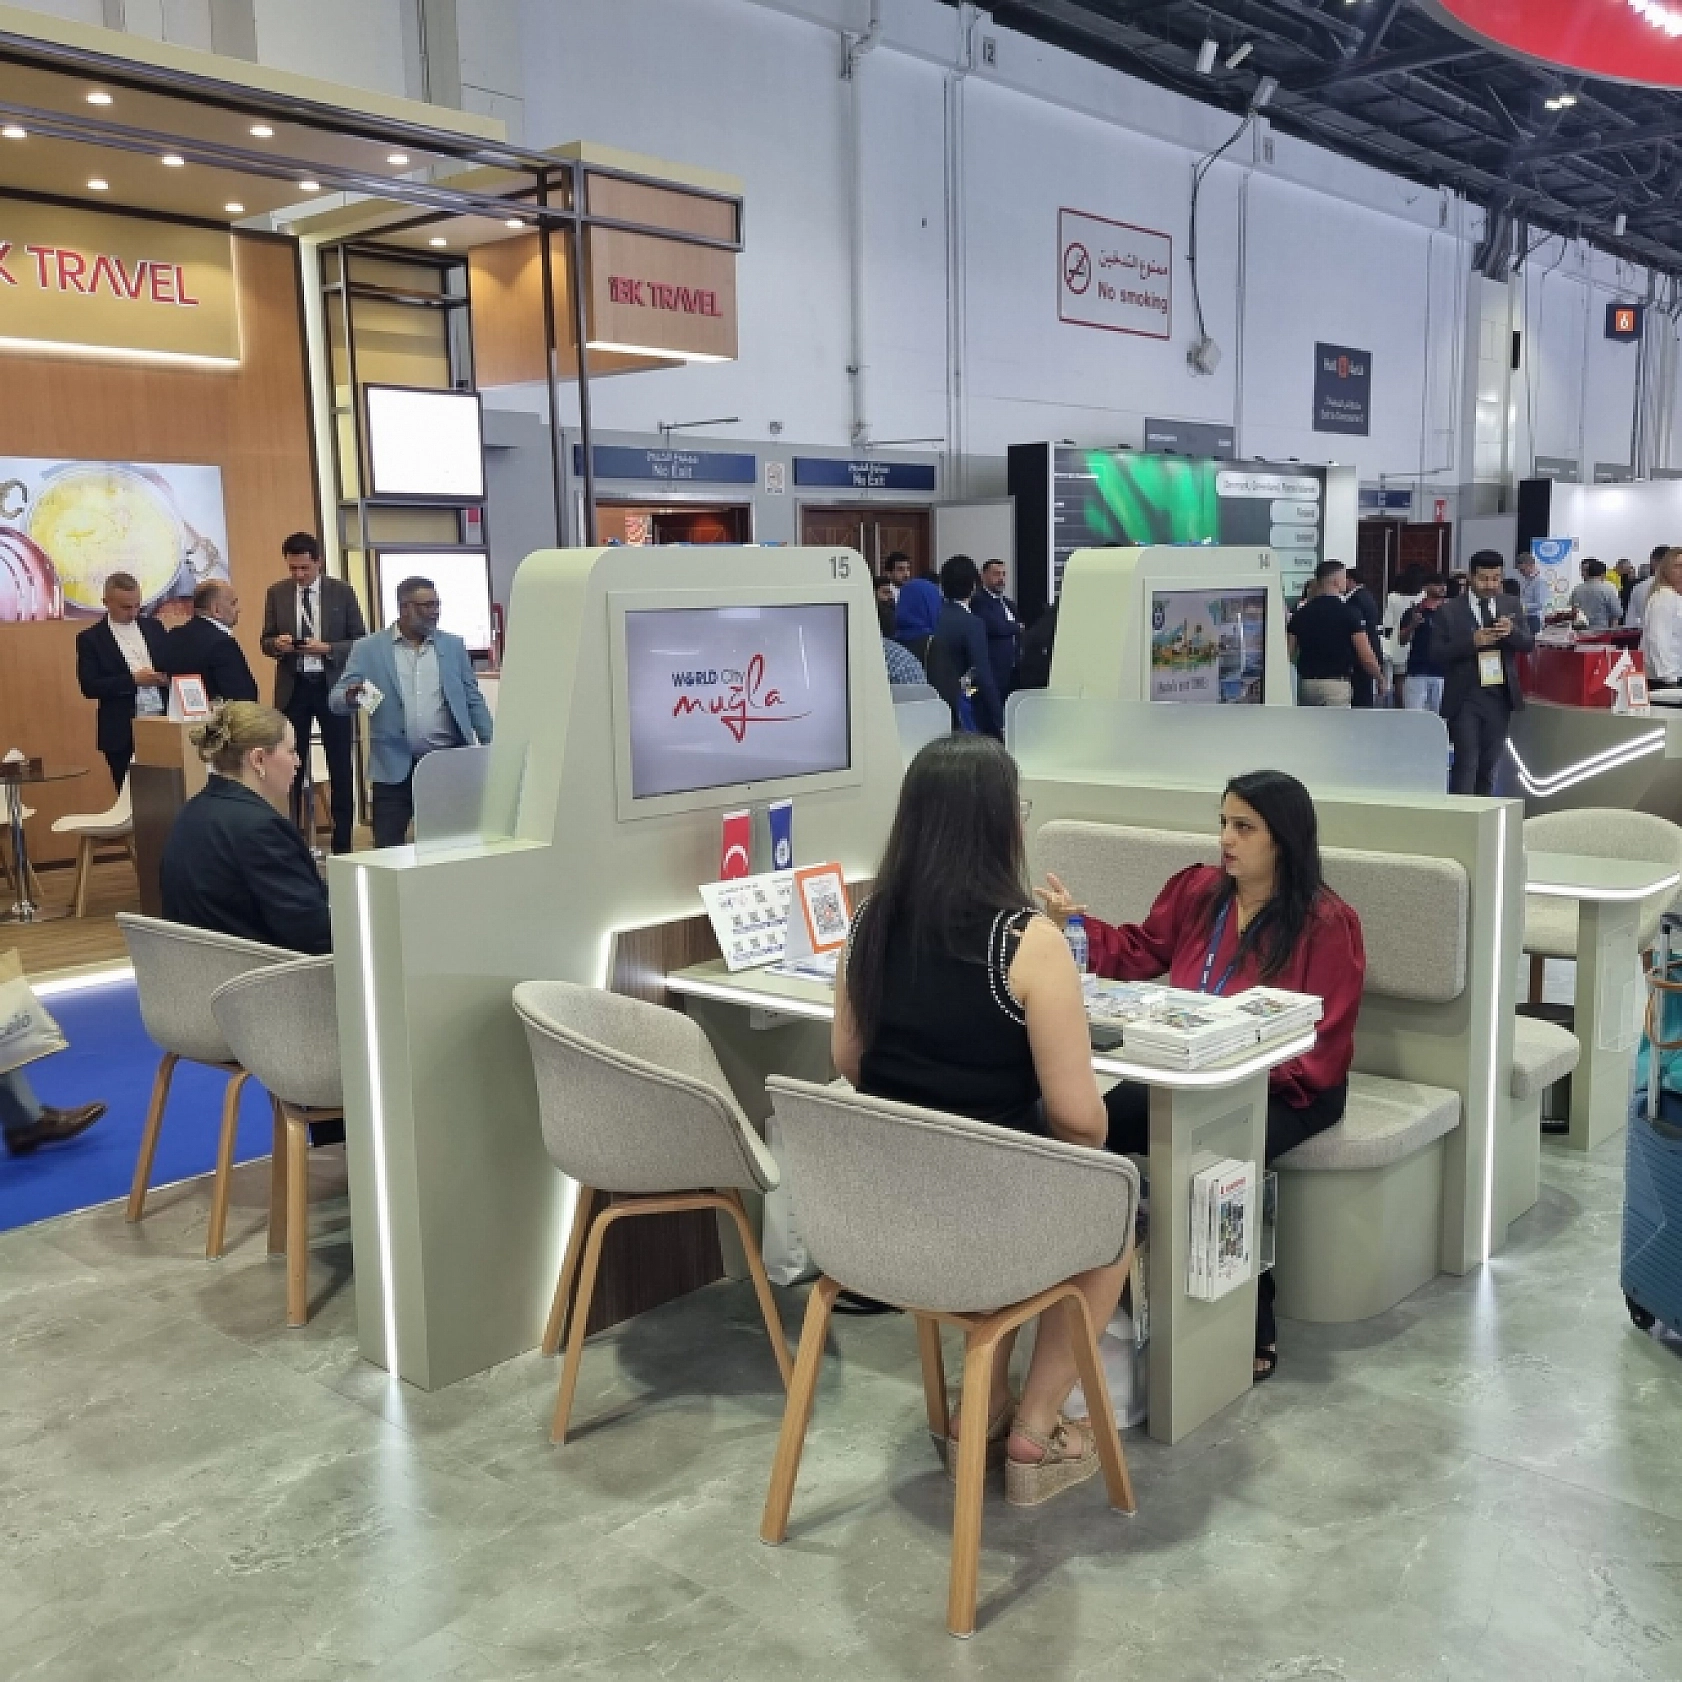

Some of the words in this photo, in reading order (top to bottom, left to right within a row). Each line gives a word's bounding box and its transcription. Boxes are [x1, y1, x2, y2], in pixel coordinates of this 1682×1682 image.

[25, 244, 200, 307] TRAVEL
[647, 281, 724, 318] TRAVEL
[1098, 280, 1116, 302] No
[1120, 289, 1168, 316] smoking
[829, 555, 851, 579] 15
[720, 667, 746, 686] City
